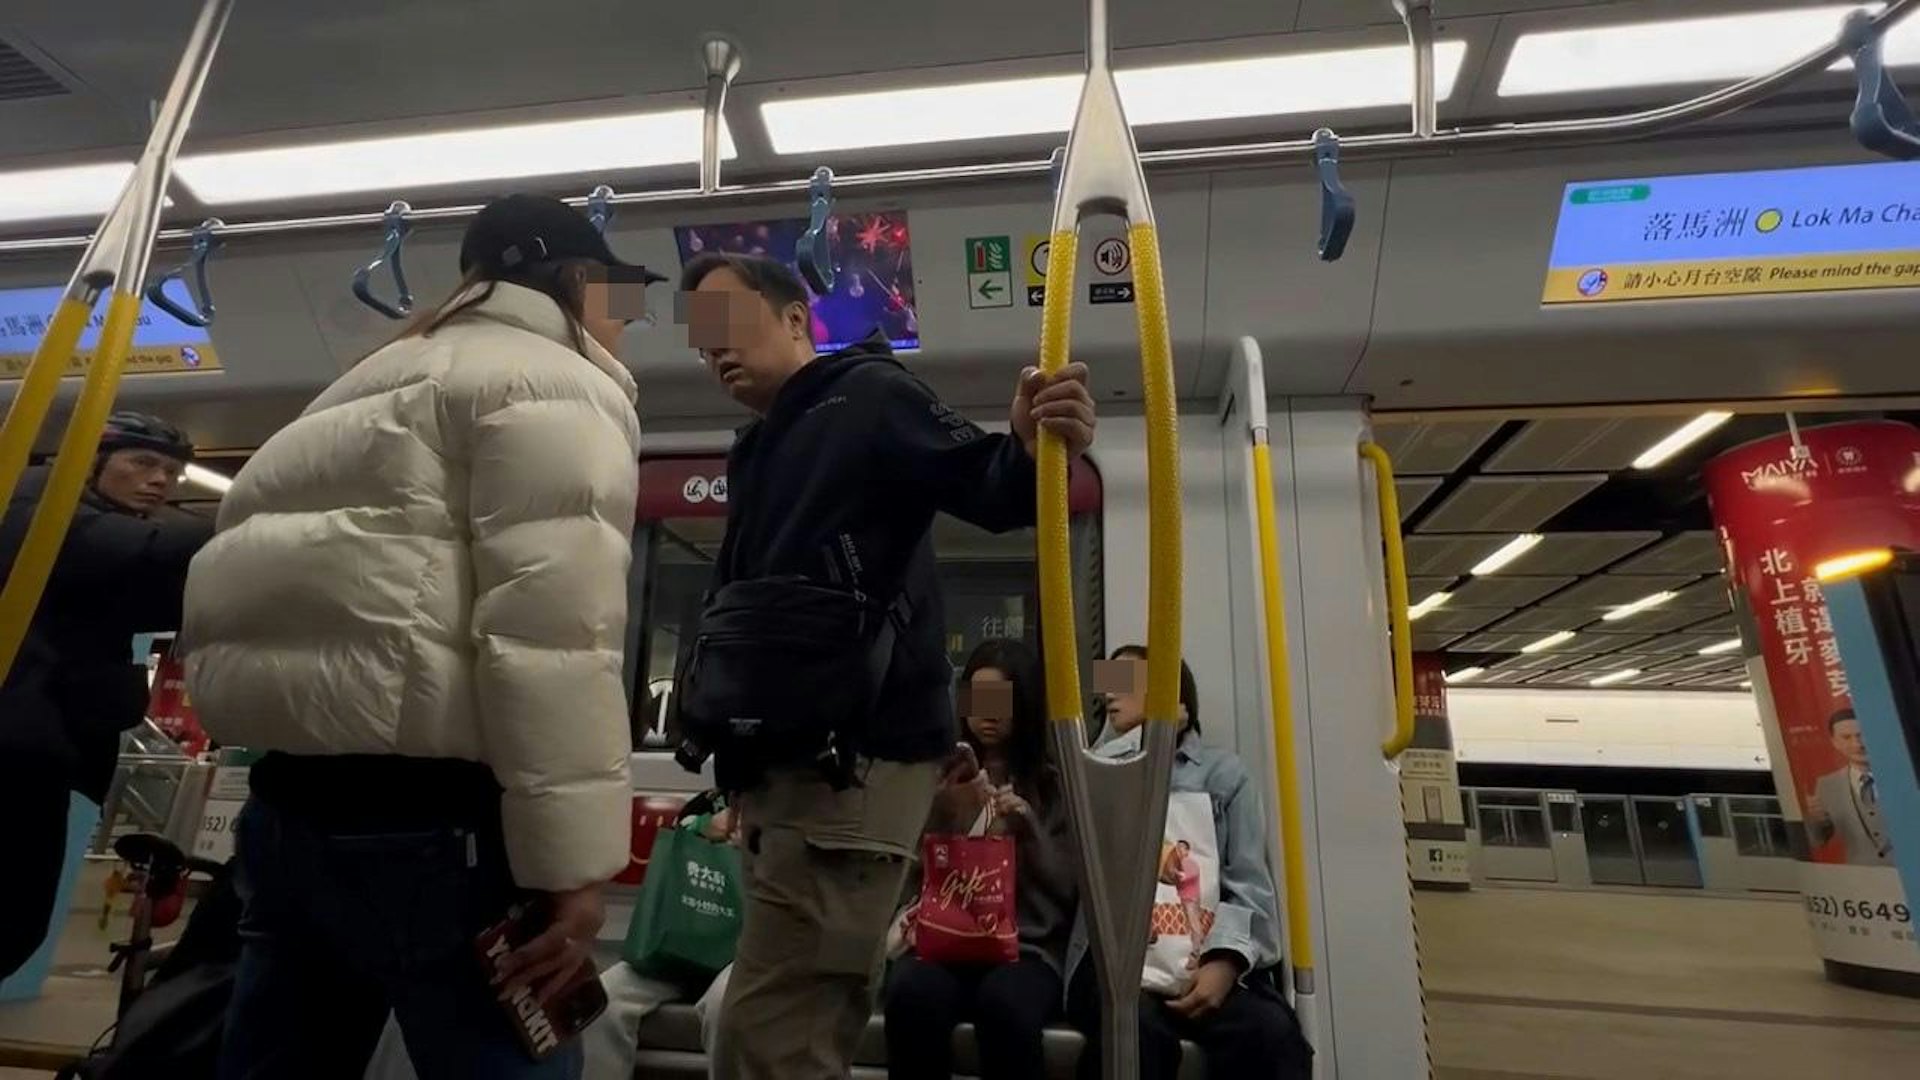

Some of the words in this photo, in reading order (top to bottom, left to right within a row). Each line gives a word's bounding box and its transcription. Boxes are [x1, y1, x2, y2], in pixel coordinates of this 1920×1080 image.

[1643, 207, 1749, 241] 落馬洲
[1791, 207, 1833, 228] Lok
[1839, 205, 1874, 225] Ma
[1623, 266, 1763, 290] 請小心月台空隙
[1769, 266, 1818, 281] Please
[1822, 263, 1863, 278] mind
[1865, 262, 1892, 275] the
[1760, 548, 1813, 665] 北上植牙
